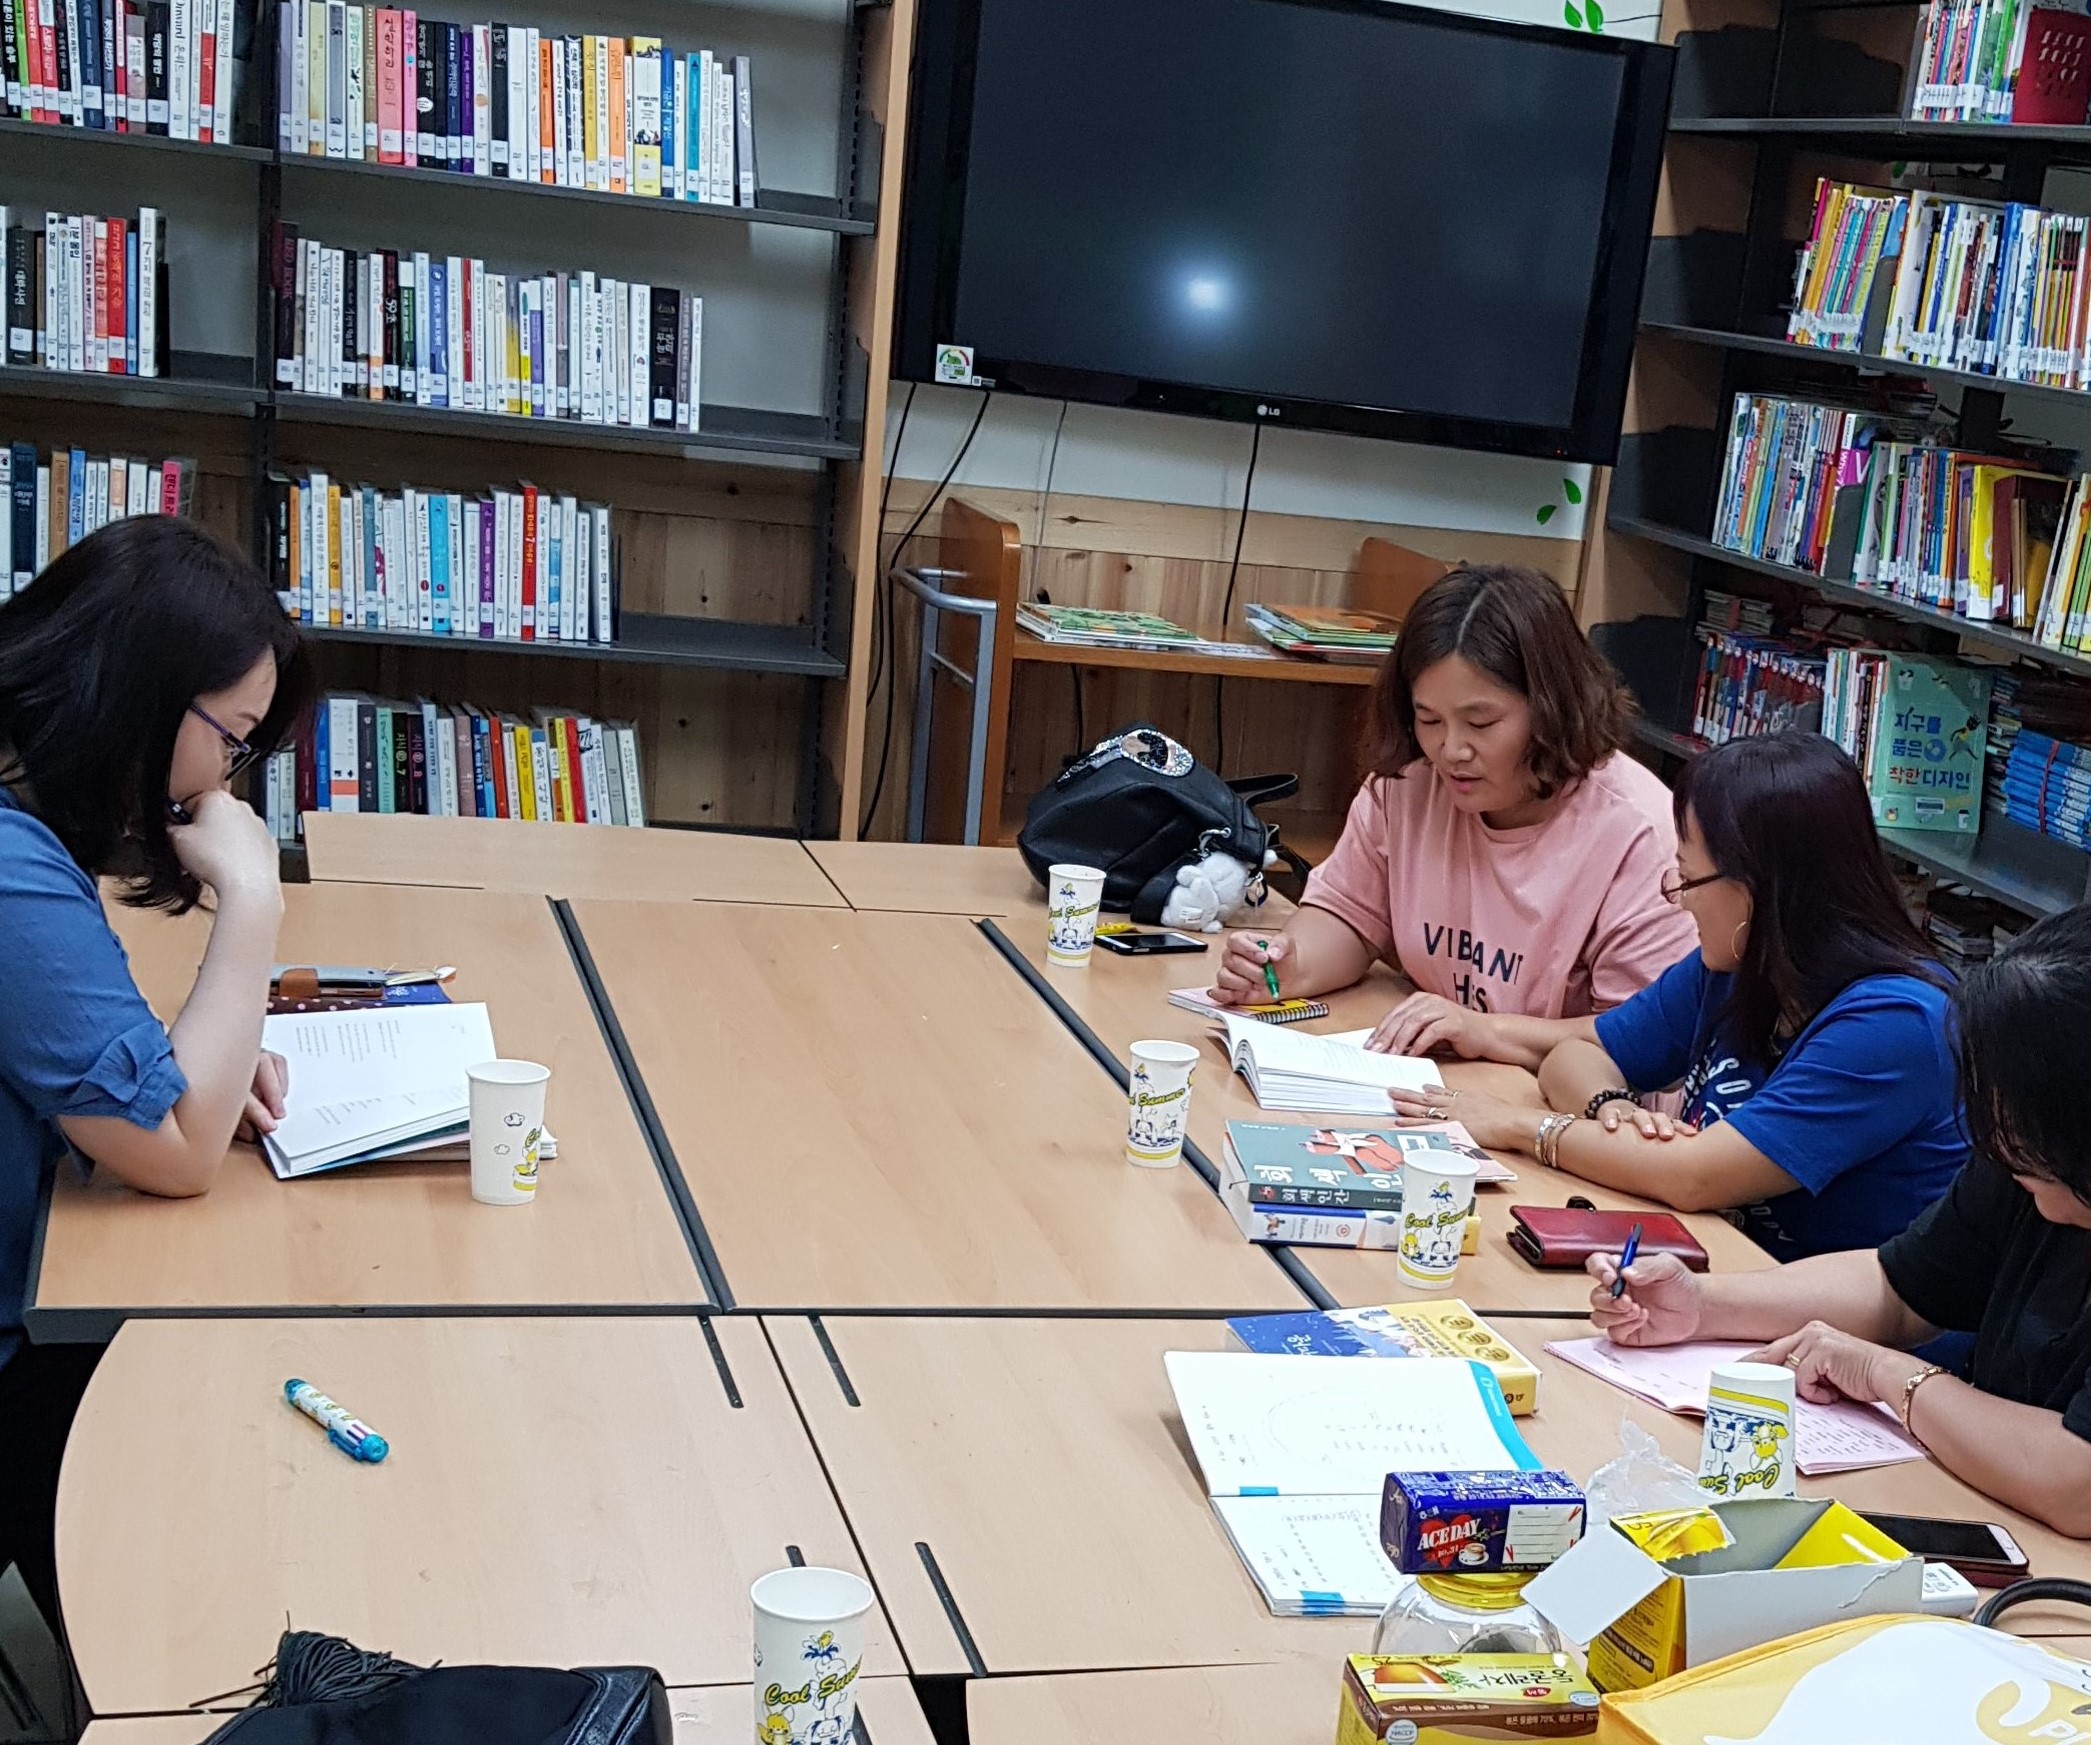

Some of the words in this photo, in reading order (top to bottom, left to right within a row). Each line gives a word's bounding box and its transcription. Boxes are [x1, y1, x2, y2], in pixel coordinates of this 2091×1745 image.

[1894, 706, 1942, 734] 지구를
[1889, 767, 1921, 787] 착한
[1922, 769, 1970, 790] 디자인
[1253, 1164, 1403, 1190] 회색인
[1281, 1187, 1350, 1205] 회색인간
[1404, 1212, 1434, 1229] Cool
[1734, 1463, 1780, 1493] Cool
[1479, 1669, 1575, 1686] 둥굴레차
[764, 1682, 812, 1707] Cool
